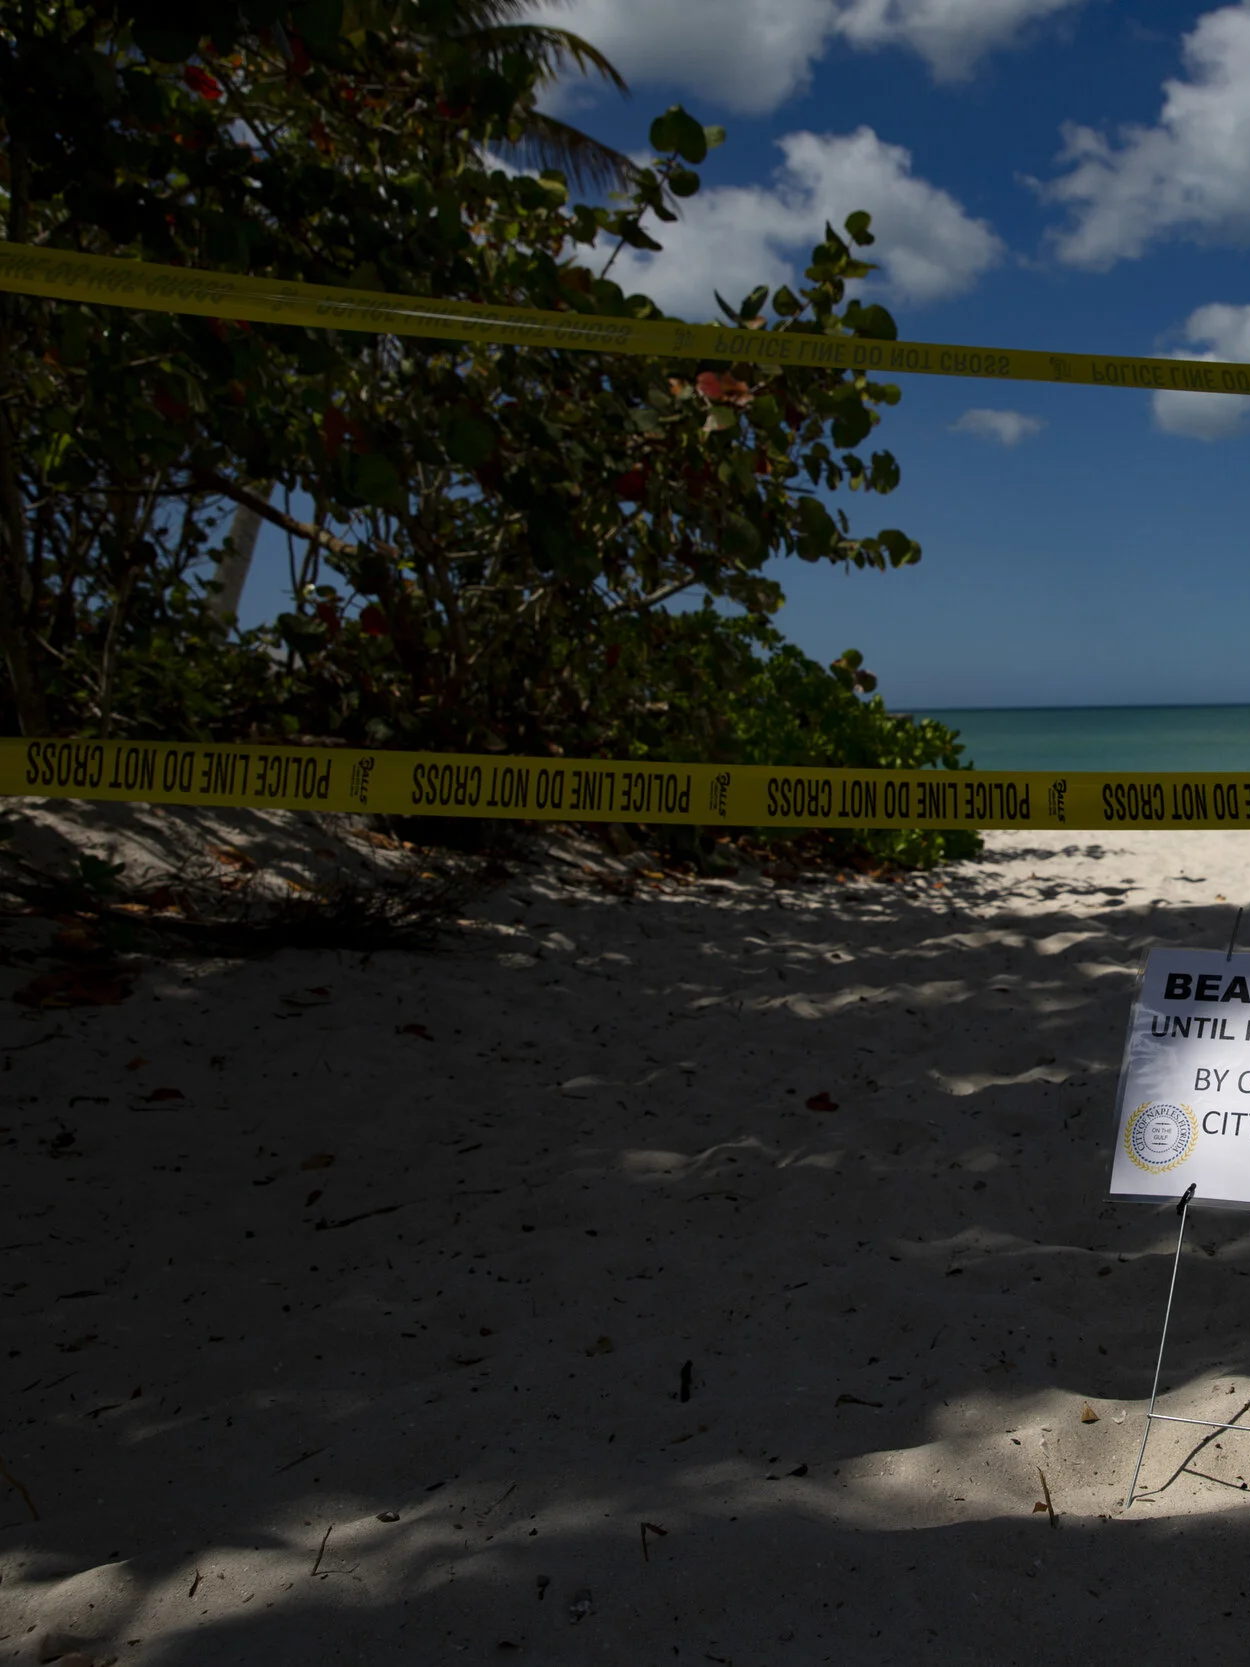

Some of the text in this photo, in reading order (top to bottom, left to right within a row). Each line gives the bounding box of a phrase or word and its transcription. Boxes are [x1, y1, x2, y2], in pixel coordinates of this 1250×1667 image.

[27, 741, 103, 788] CROSS
[109, 747, 157, 790] NOT
[163, 750, 195, 792] DO
[200, 752, 250, 795] LINE
[255, 755, 332, 799] POLICE
[412, 763, 481, 807] CROSS
[488, 767, 530, 808] NOT
[536, 769, 564, 809] DO
[570, 771, 615, 811] LINE
[621, 773, 690, 813] POLICE
[768, 778, 832, 817] CROSS
[838, 780, 876, 818] NOT
[884, 781, 909, 819] DO
[917, 782, 957, 819] LINE
[965, 782, 1030, 820] POLICE
[1103, 784, 1164, 820] CROSS
[1172, 784, 1208, 820] NOT
[1213, 784, 1239, 820] DO
[1151, 1015, 1235, 1041] UNTIL
[1195, 1068, 1229, 1092] BY
